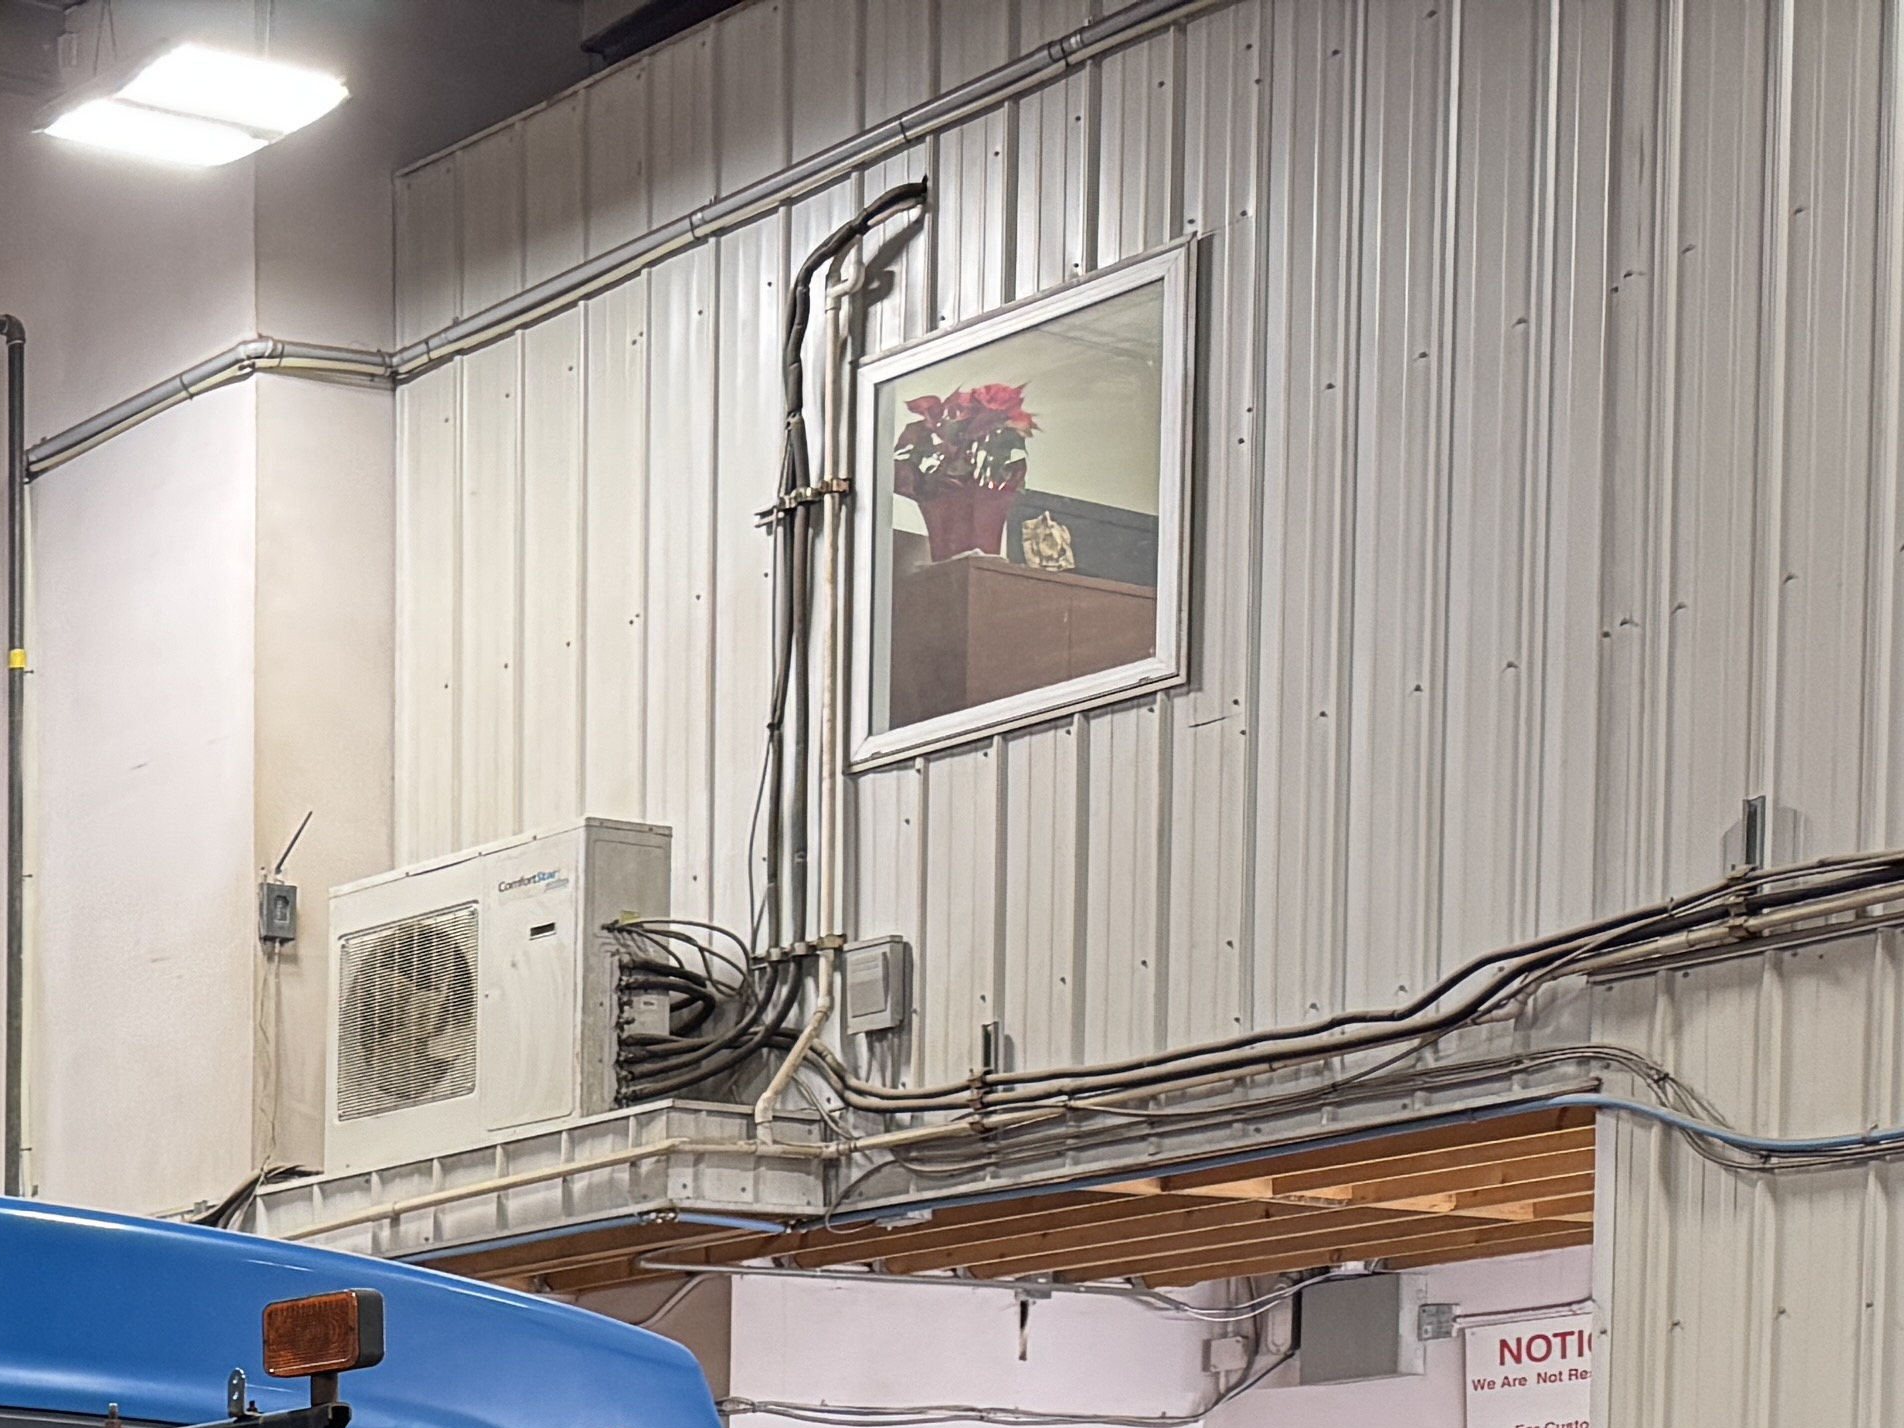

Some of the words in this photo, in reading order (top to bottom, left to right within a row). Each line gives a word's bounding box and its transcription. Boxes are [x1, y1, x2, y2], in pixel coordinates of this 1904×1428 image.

[1499, 1329, 1592, 1366] NOTI
[1472, 1378, 1496, 1392] We
[1500, 1375, 1528, 1389] Are
[1536, 1370, 1563, 1384] Not
[1568, 1368, 1591, 1382] Re
